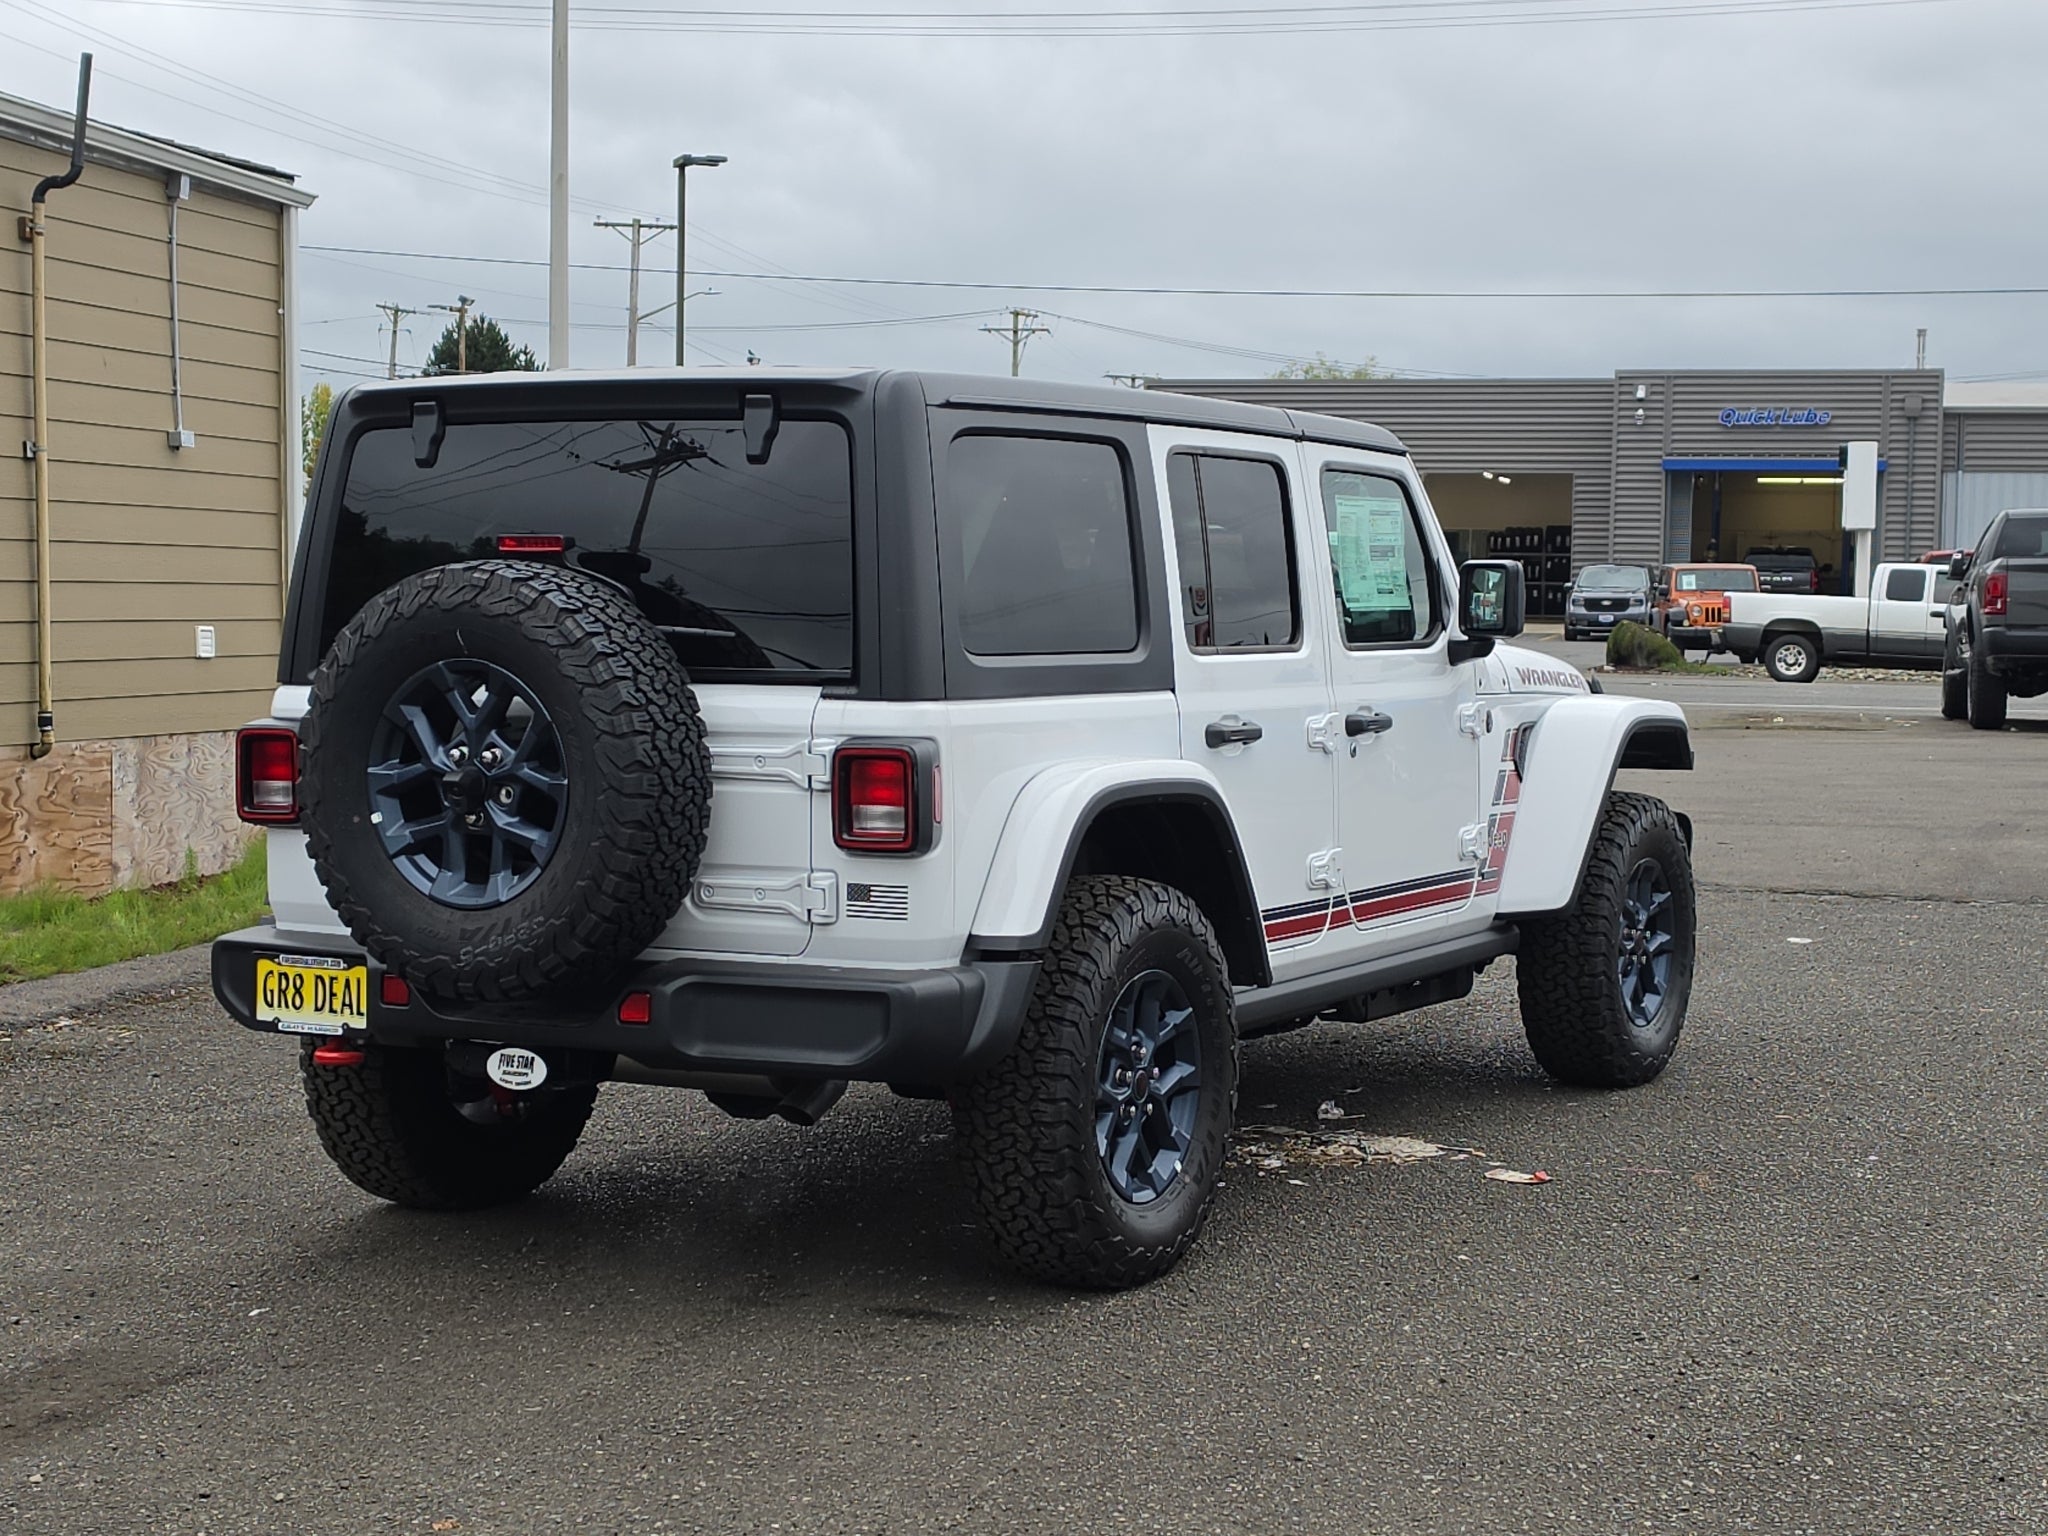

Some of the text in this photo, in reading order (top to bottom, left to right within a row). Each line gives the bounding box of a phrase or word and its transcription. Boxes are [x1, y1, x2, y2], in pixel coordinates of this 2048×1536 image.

[1719, 407, 1832, 427] Quick Lube
[1515, 666, 1586, 691] WRANGLER
[262, 970, 365, 1017] GR8 DEAL
[498, 1053, 516, 1070] FIVE
[516, 1055, 535, 1074] STAR
